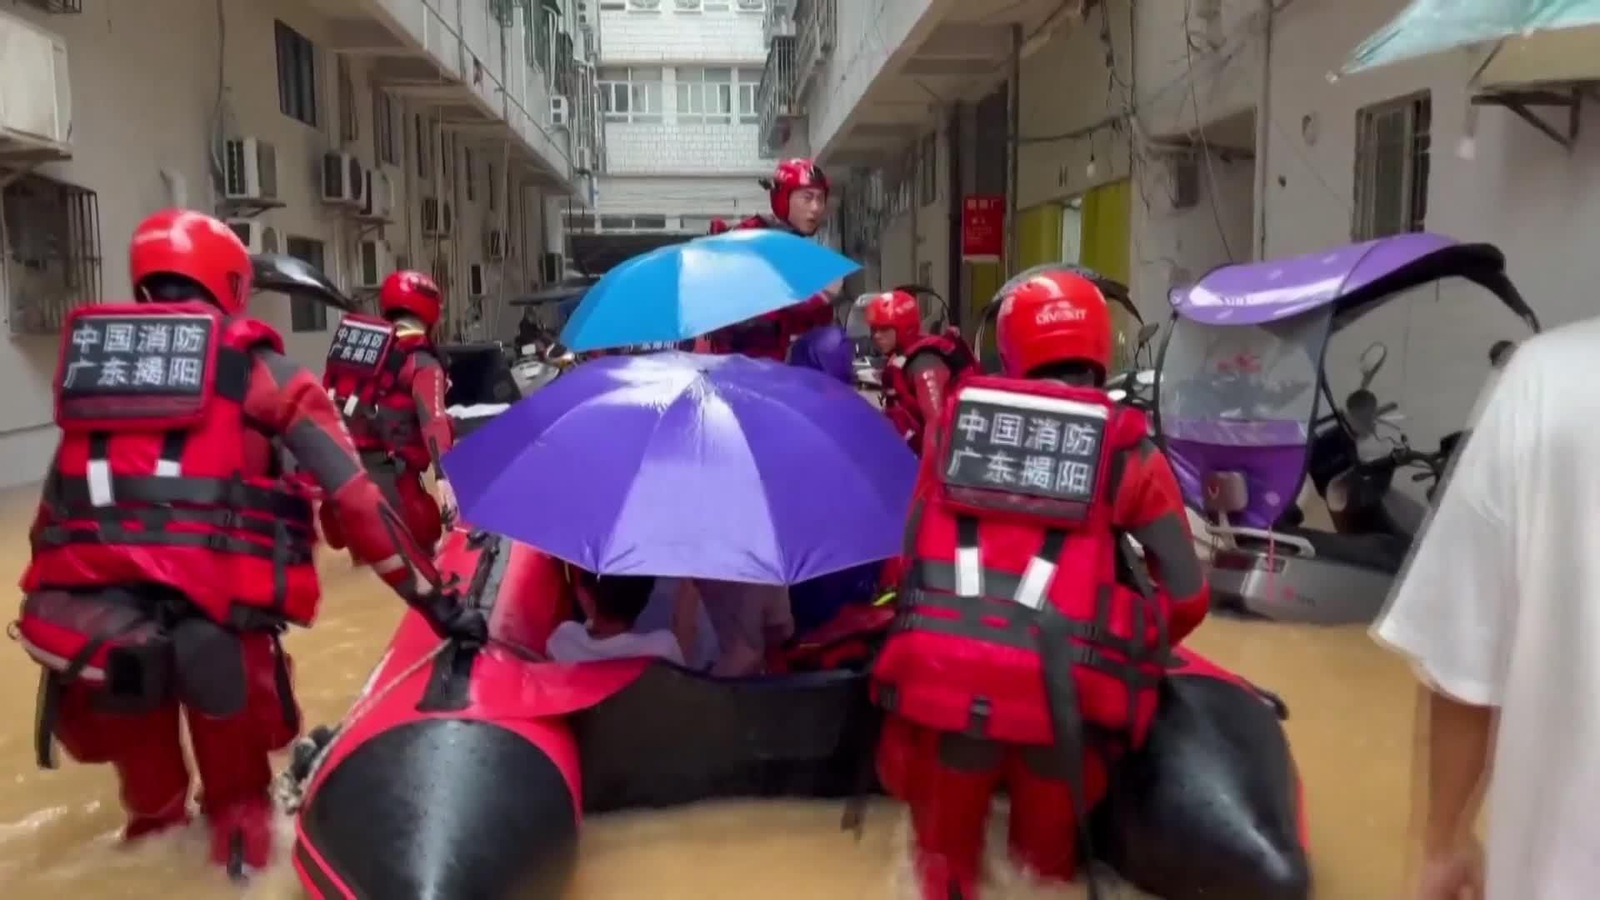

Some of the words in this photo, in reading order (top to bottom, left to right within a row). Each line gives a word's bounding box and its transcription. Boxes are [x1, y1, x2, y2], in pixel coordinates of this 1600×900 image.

[72, 323, 206, 354] 中国消防
[63, 356, 203, 389] 广东揭阳
[957, 408, 1097, 456] 中国消防
[947, 447, 1090, 494] 广东揭阳
